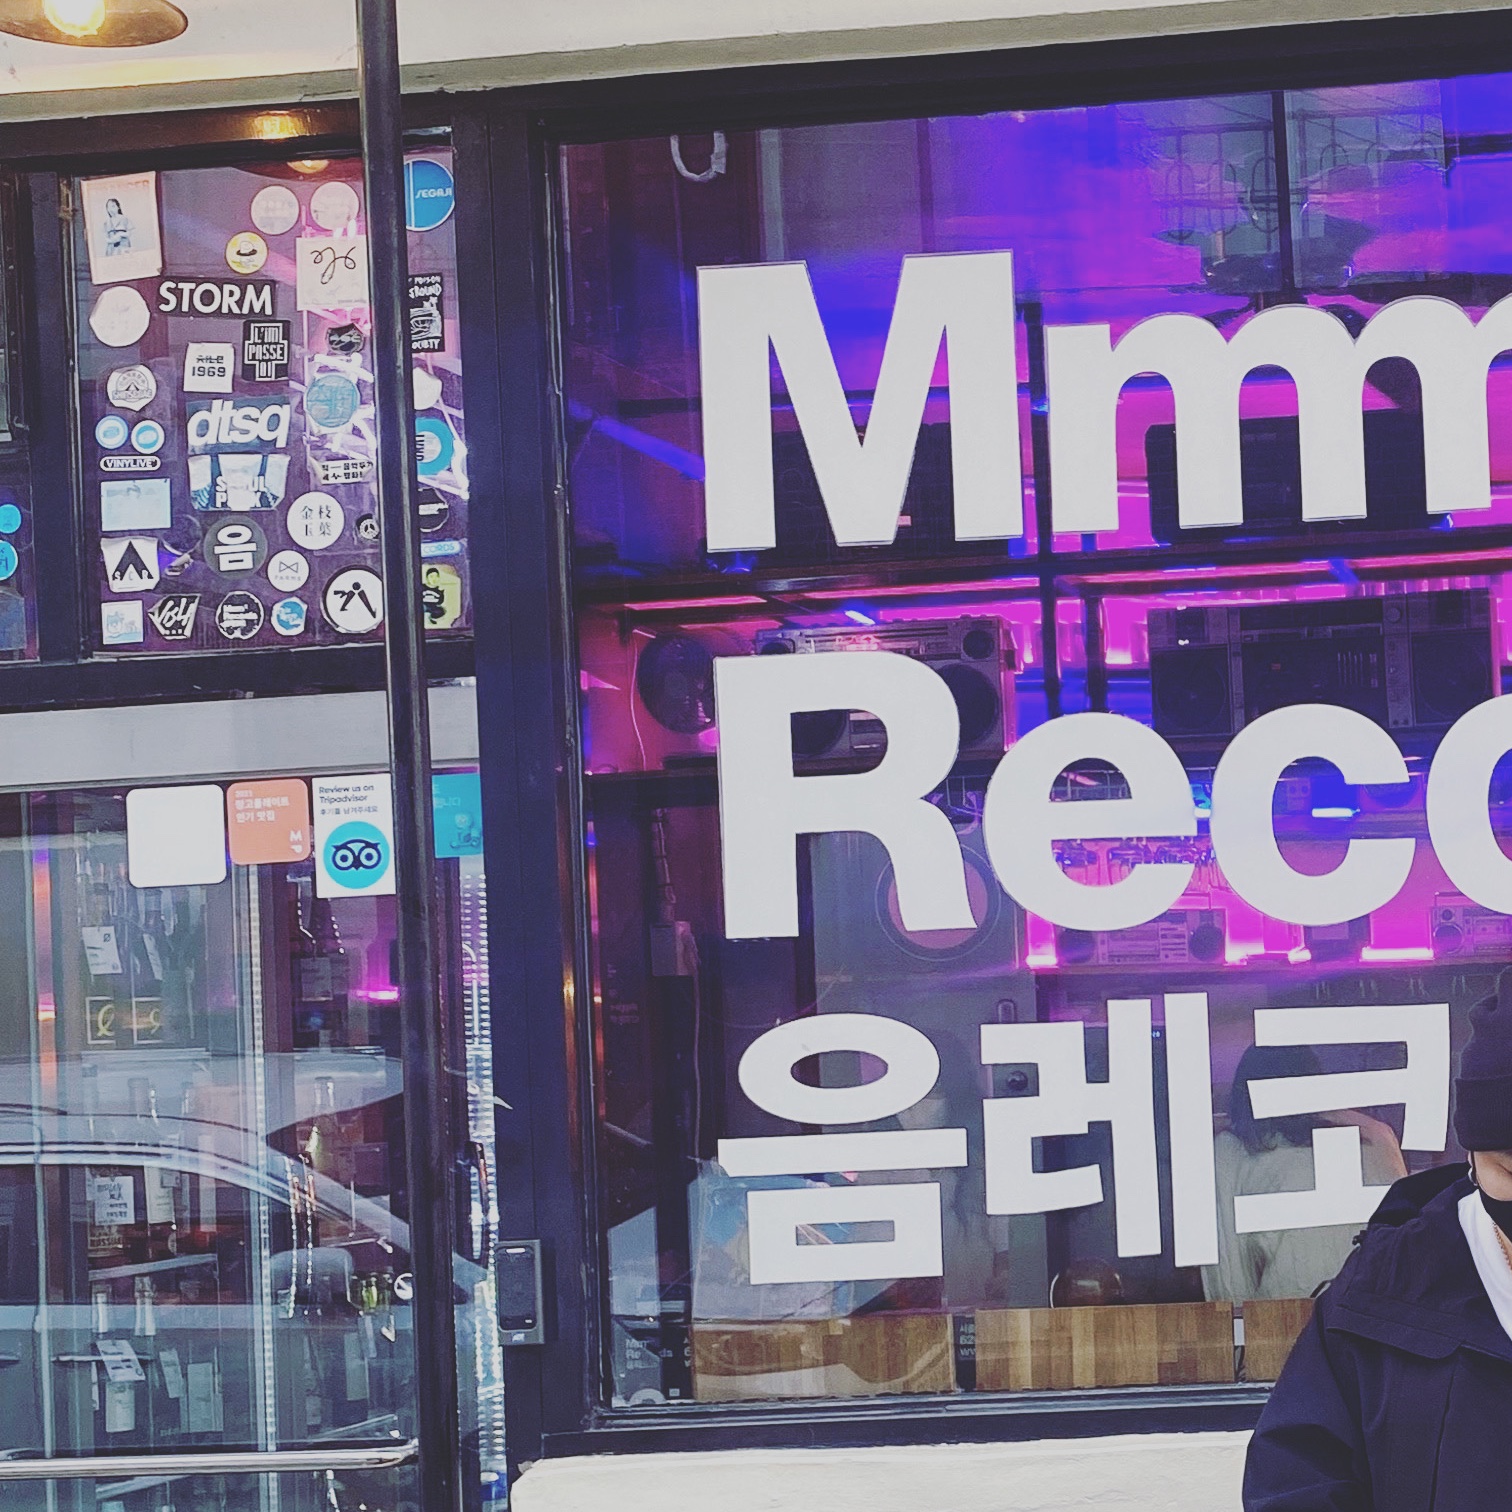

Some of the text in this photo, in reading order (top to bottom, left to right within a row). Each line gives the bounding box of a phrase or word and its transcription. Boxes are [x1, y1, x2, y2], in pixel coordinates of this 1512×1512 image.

[158, 280, 273, 316] STORM
[191, 366, 226, 377] 1969
[187, 399, 291, 448] dtsq
[213, 524, 257, 572] 음
[318, 786, 350, 794] Review
[319, 794, 369, 804] Tripadvisor
